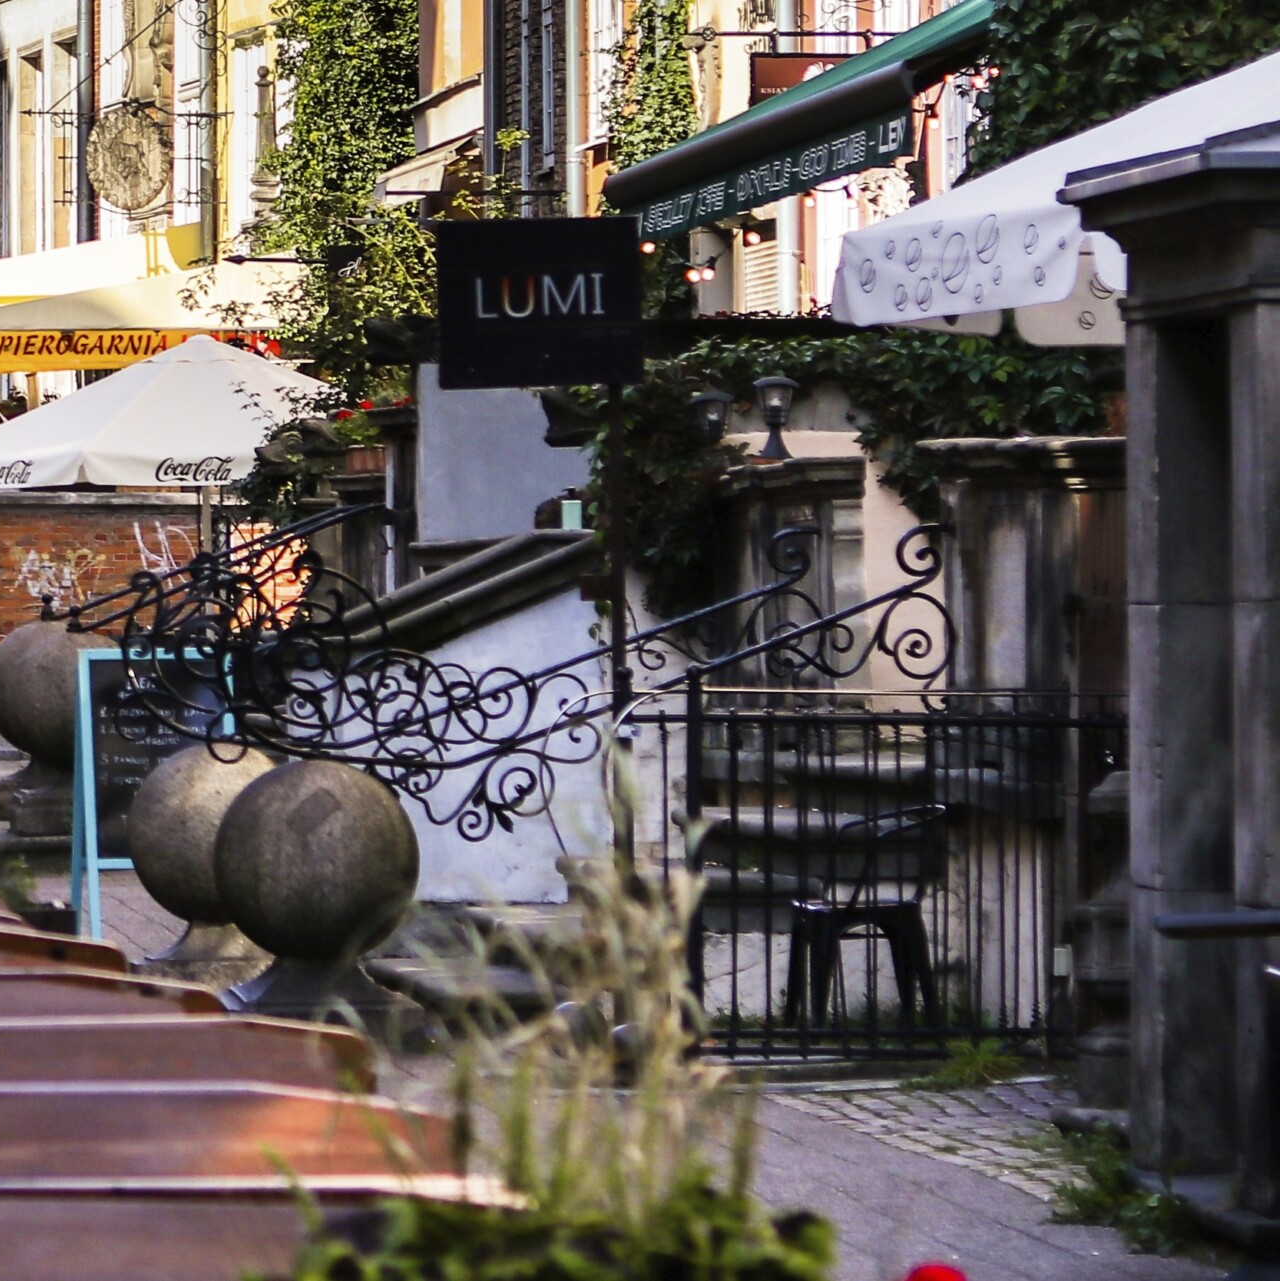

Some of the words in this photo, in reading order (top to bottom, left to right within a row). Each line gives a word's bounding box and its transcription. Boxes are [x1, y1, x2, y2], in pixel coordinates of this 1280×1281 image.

[831, 130, 867, 171] TIMES
[475, 273, 605, 318] LUMI
[154, 456, 236, 483] Coca-Cola
